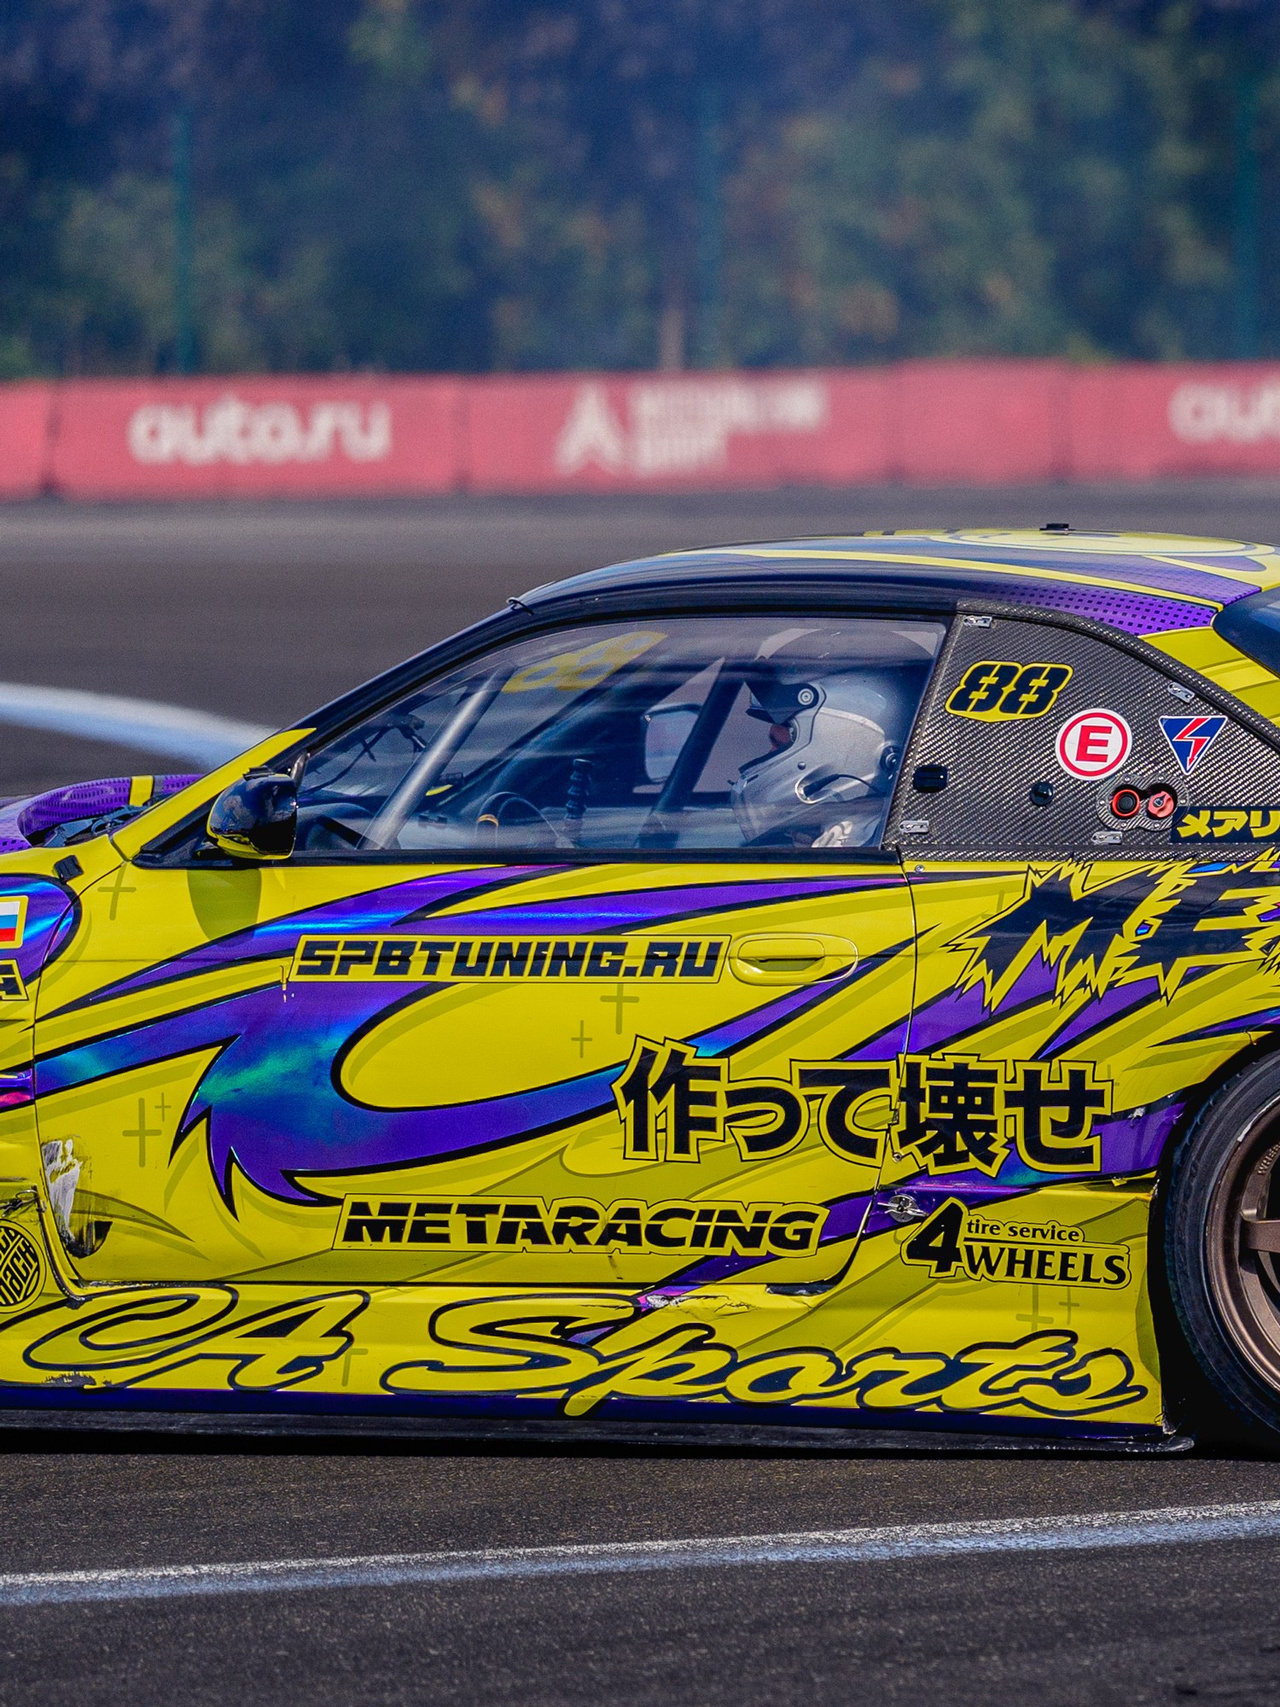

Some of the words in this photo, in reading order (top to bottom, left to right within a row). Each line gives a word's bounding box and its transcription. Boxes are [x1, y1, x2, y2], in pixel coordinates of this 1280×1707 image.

[946, 661, 1072, 721] 88
[1077, 725, 1113, 763] E
[296, 940, 724, 978] SPBTUNING.RU
[617, 1041, 1108, 1171] 作って壊せ
[343, 1200, 818, 1252] METARACING
[906, 1202, 964, 1274] 4
[964, 1244, 1127, 1285] WHEELS
[966, 1218, 1001, 1236] tire
[1007, 1224, 1080, 1242] service
[379, 1290, 1150, 1418] Sports
